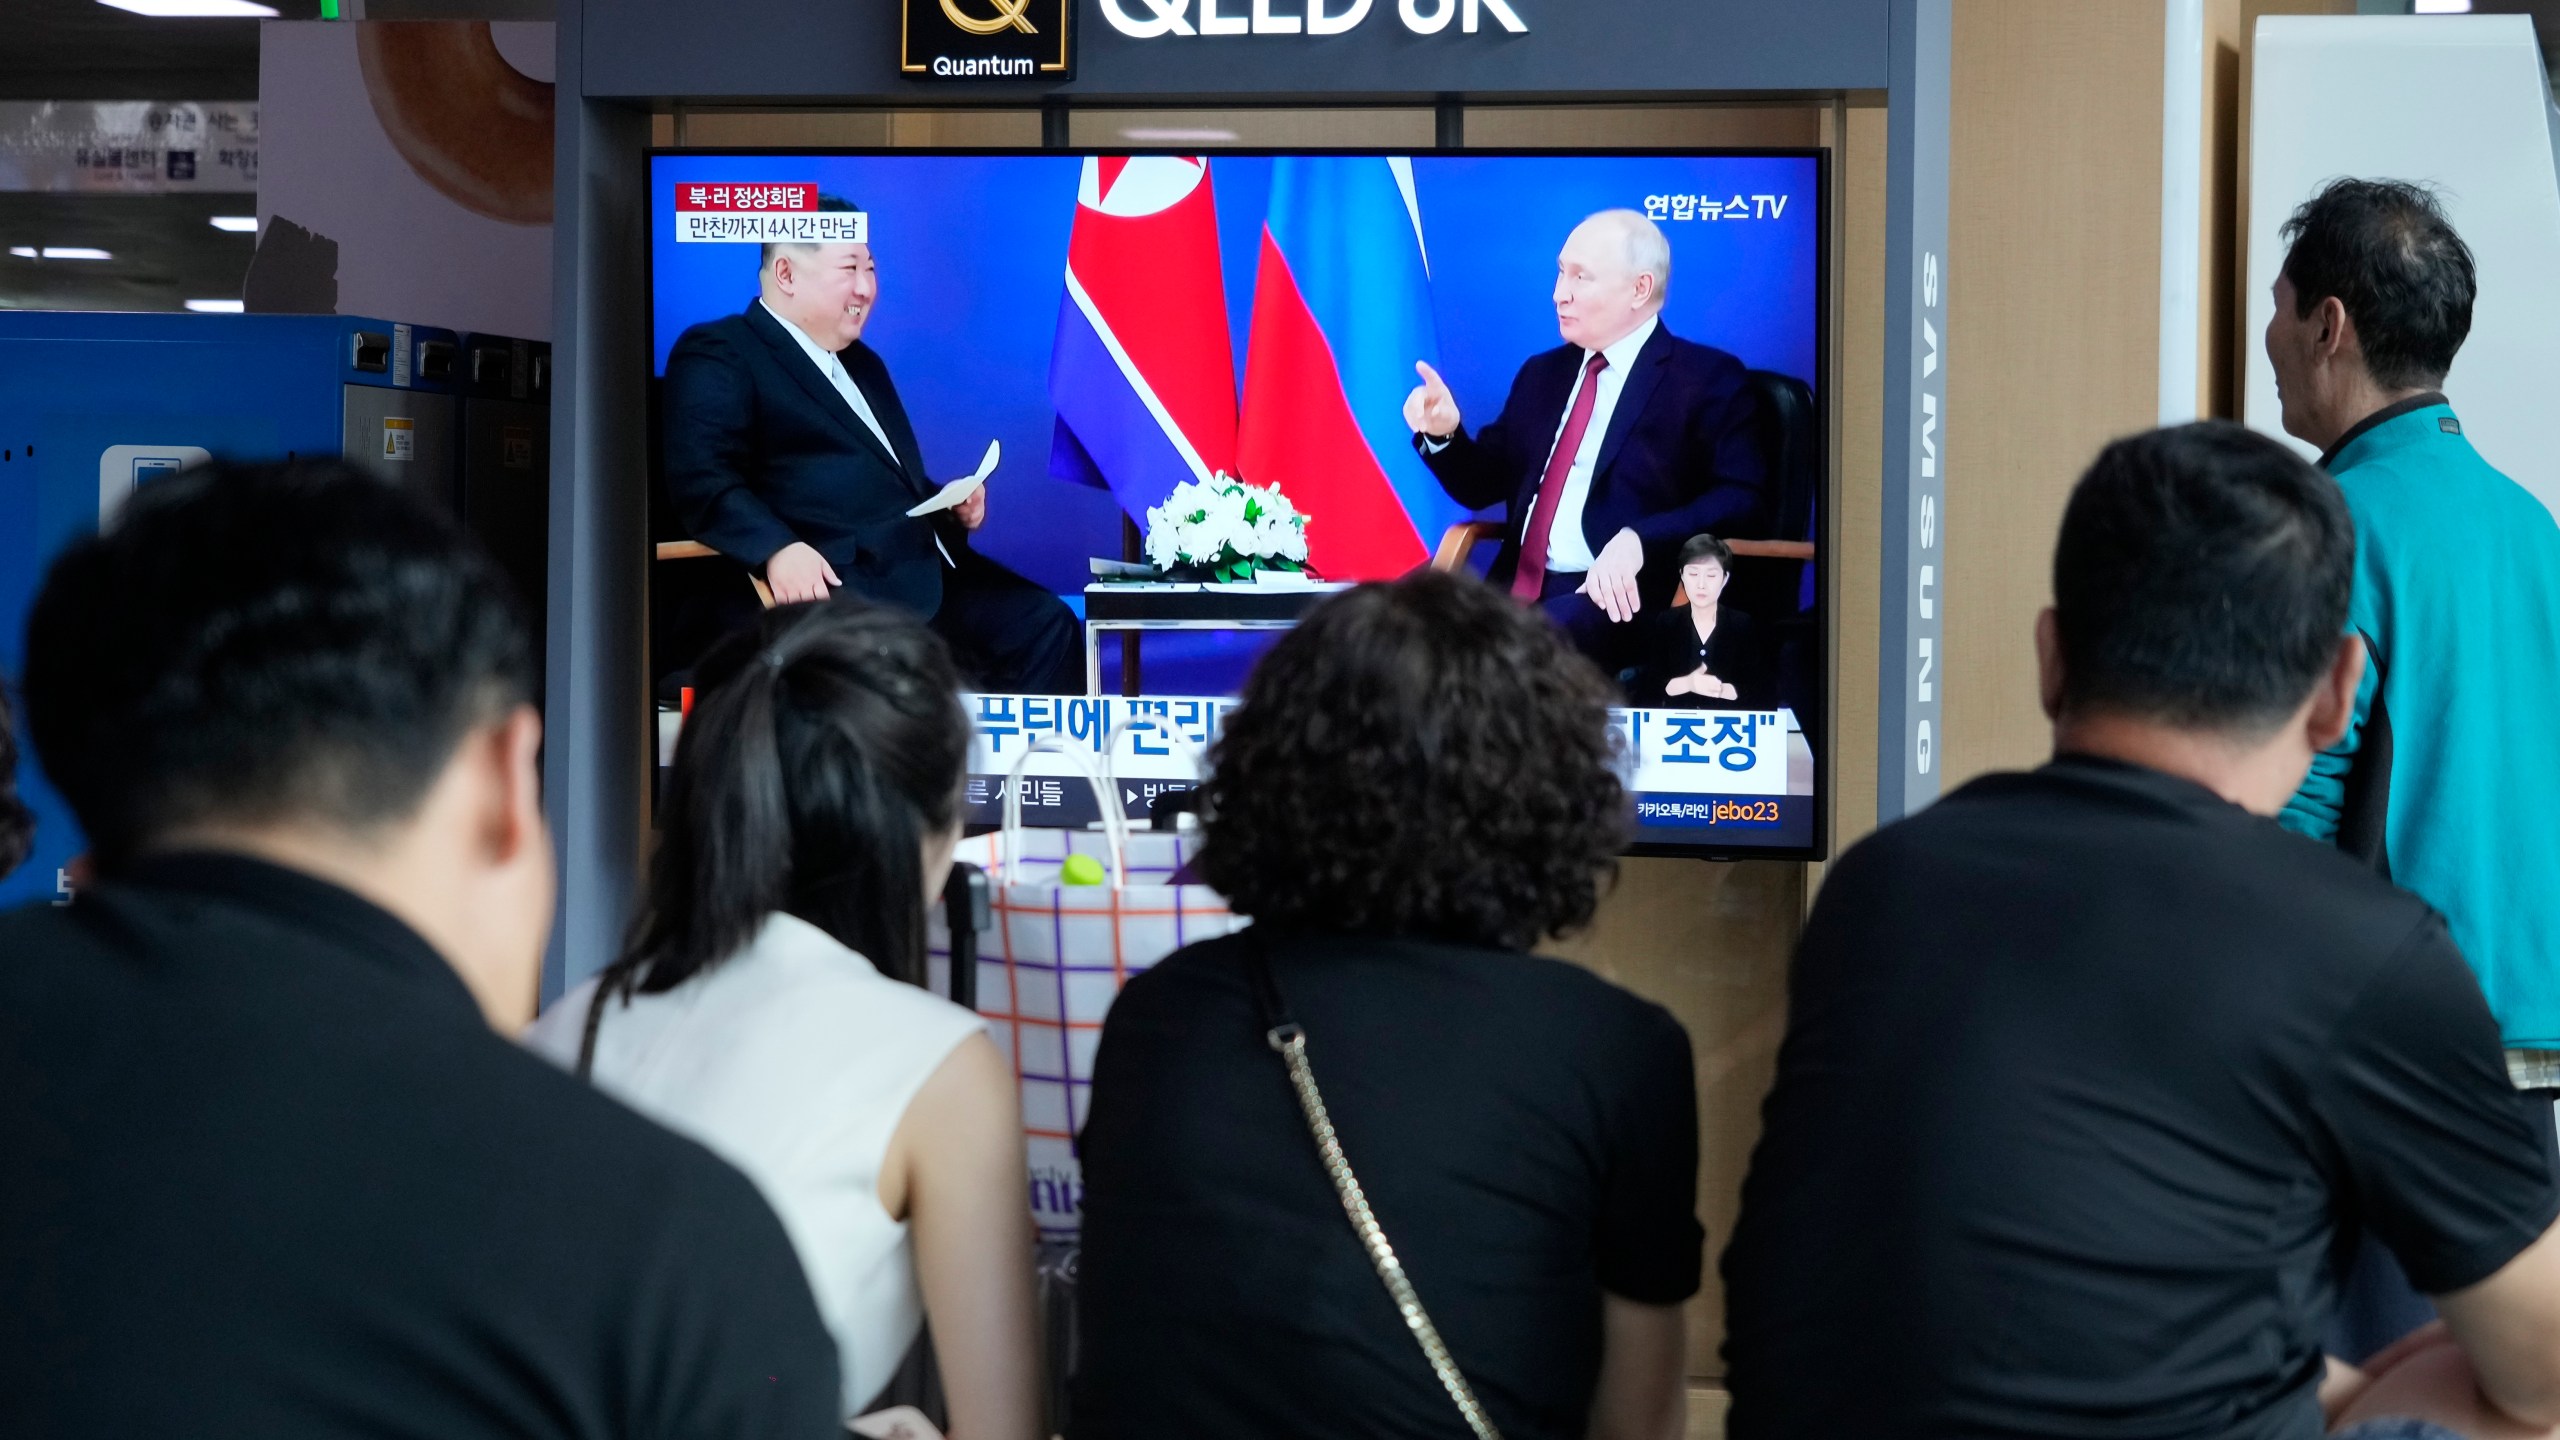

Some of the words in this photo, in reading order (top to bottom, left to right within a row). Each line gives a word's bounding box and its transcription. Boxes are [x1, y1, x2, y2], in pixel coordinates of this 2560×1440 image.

[933, 55, 1034, 76] Quantum
[689, 186, 730, 209] 북·러
[733, 186, 806, 209] 정상회담
[1643, 194, 1788, 221] 연합뉴스TV
[690, 217, 764, 240] 만찬까지
[768, 217, 816, 240] 4시간
[820, 217, 858, 240] 만남
[1917, 251, 1938, 775] SAMSUNG
[976, 697, 1111, 753] 푸틴에
[1125, 699, 1238, 756] 편리
[1709, 800, 1779, 825] jebo23
